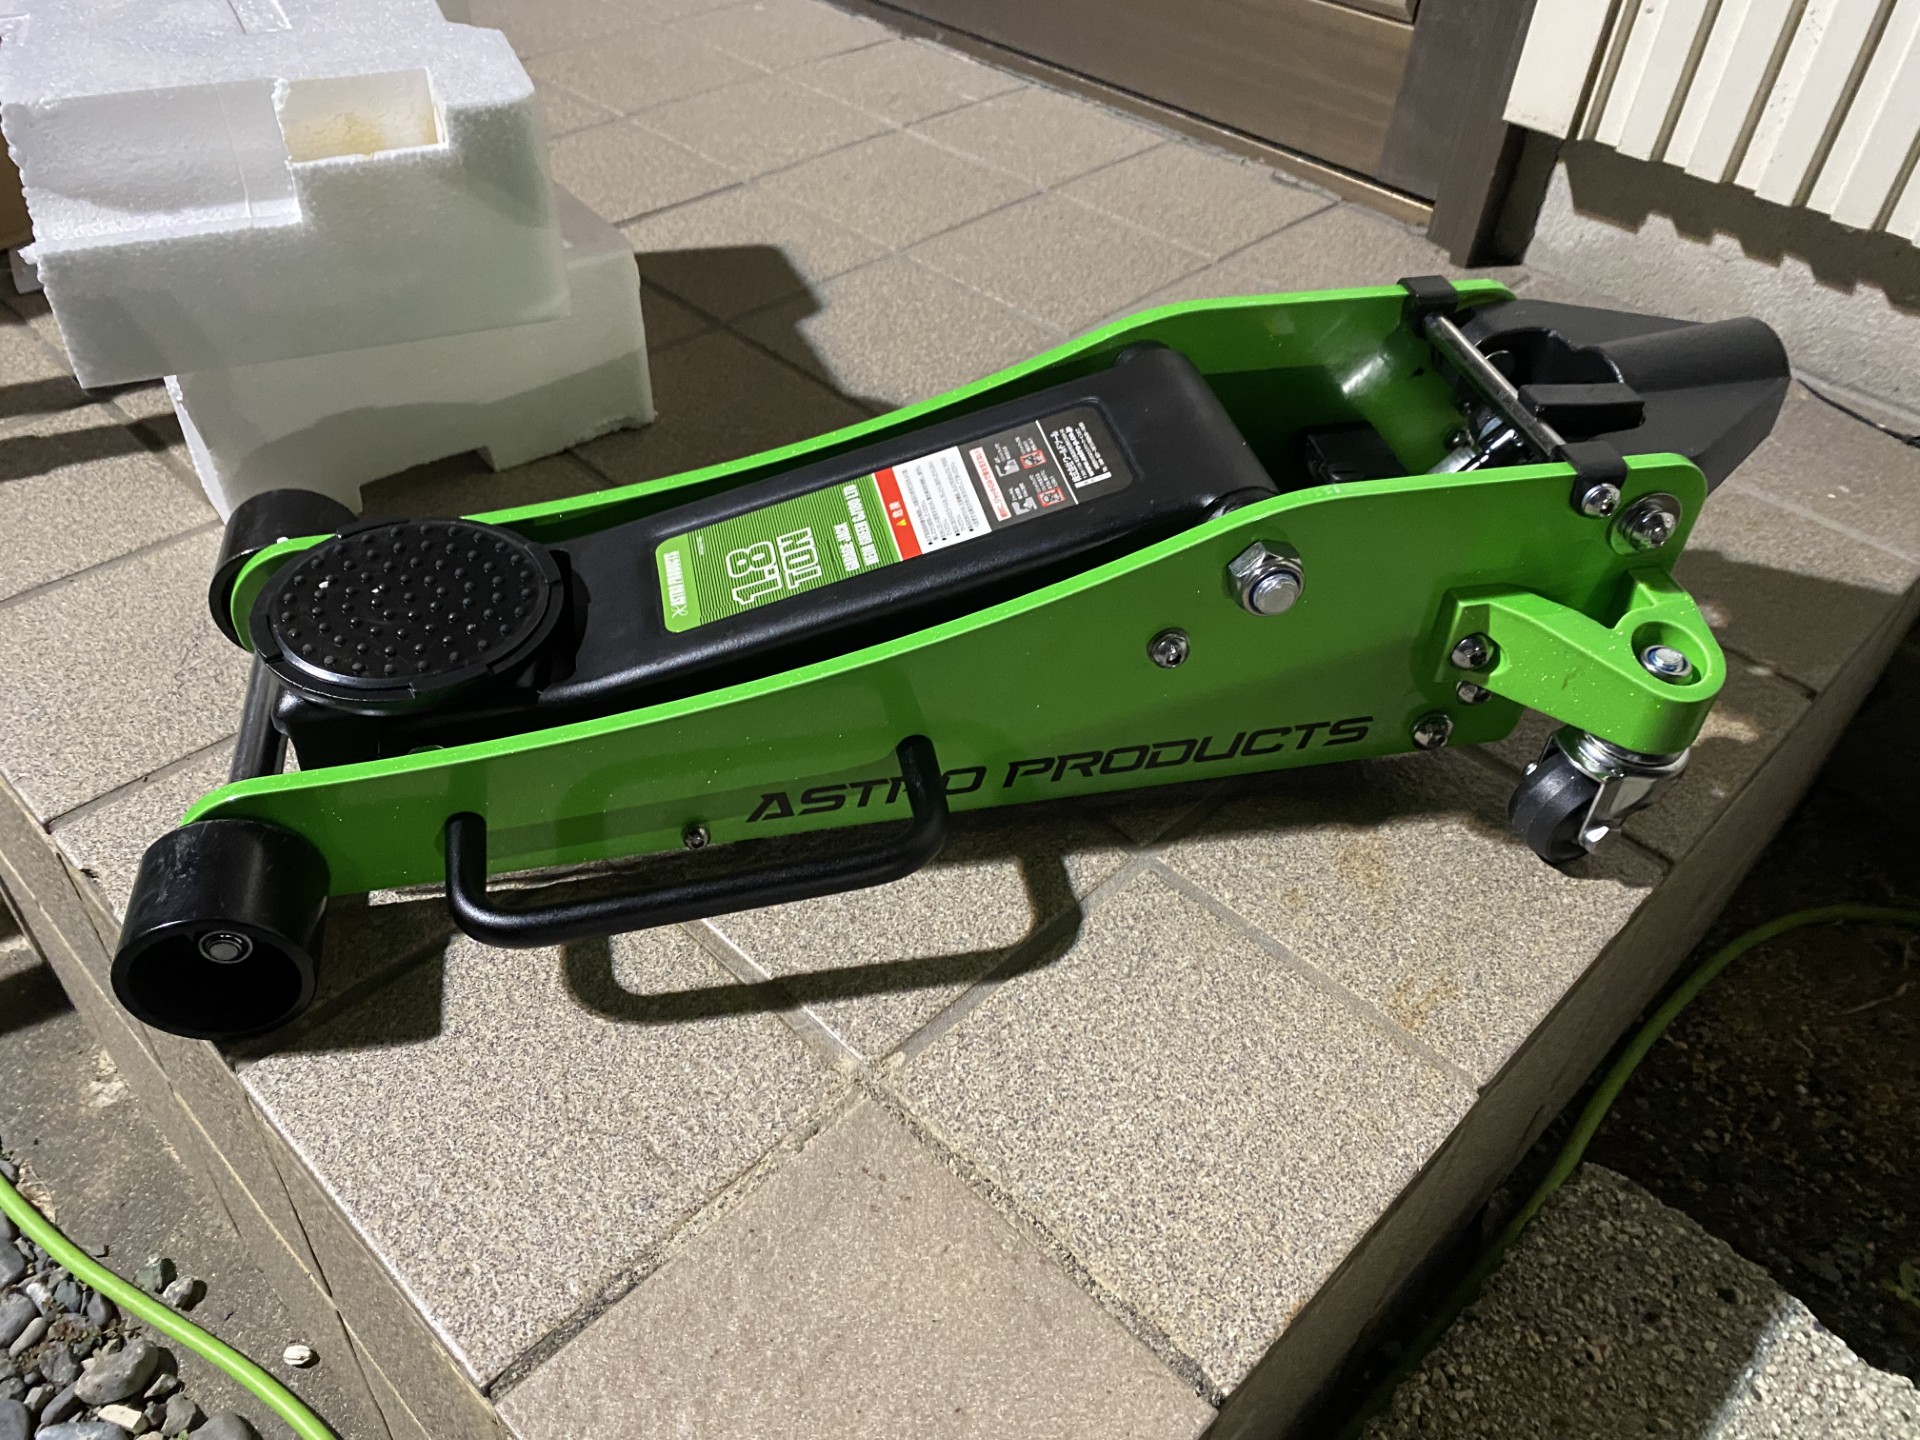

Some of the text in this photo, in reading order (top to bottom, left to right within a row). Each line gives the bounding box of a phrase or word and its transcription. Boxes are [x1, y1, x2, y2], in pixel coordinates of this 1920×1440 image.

[842, 484, 858, 499] LTD
[776, 526, 823, 589] TON
[833, 521, 860, 571] GARAGE JACK
[853, 520, 872, 545] GREEN
[860, 543, 879, 565] NEON
[663, 549, 686, 606] ASTRO PRODUCTS
[724, 538, 783, 607] 1.8
[1002, 716, 1374, 788] PRODUCTS
